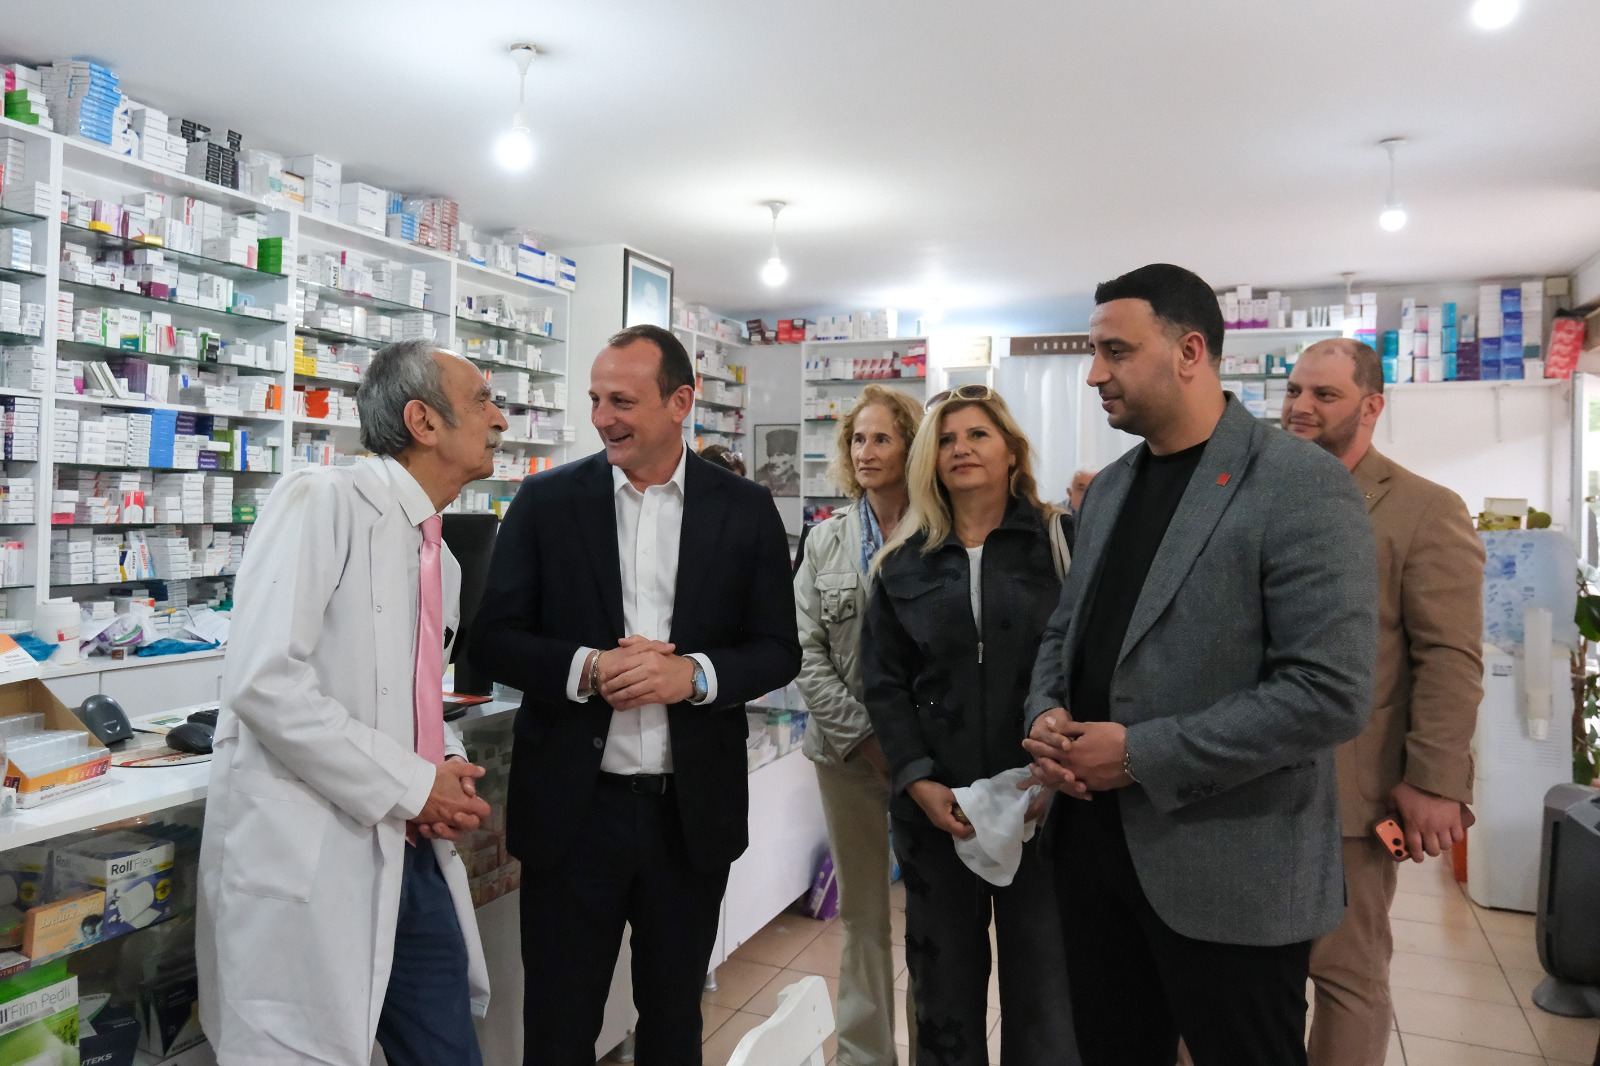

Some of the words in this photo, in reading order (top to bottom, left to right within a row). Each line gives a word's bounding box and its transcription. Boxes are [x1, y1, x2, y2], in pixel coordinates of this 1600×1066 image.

[111, 860, 133, 876] Roll
[11, 1001, 38, 1019] Film
[41, 985, 70, 1008] Pedli
